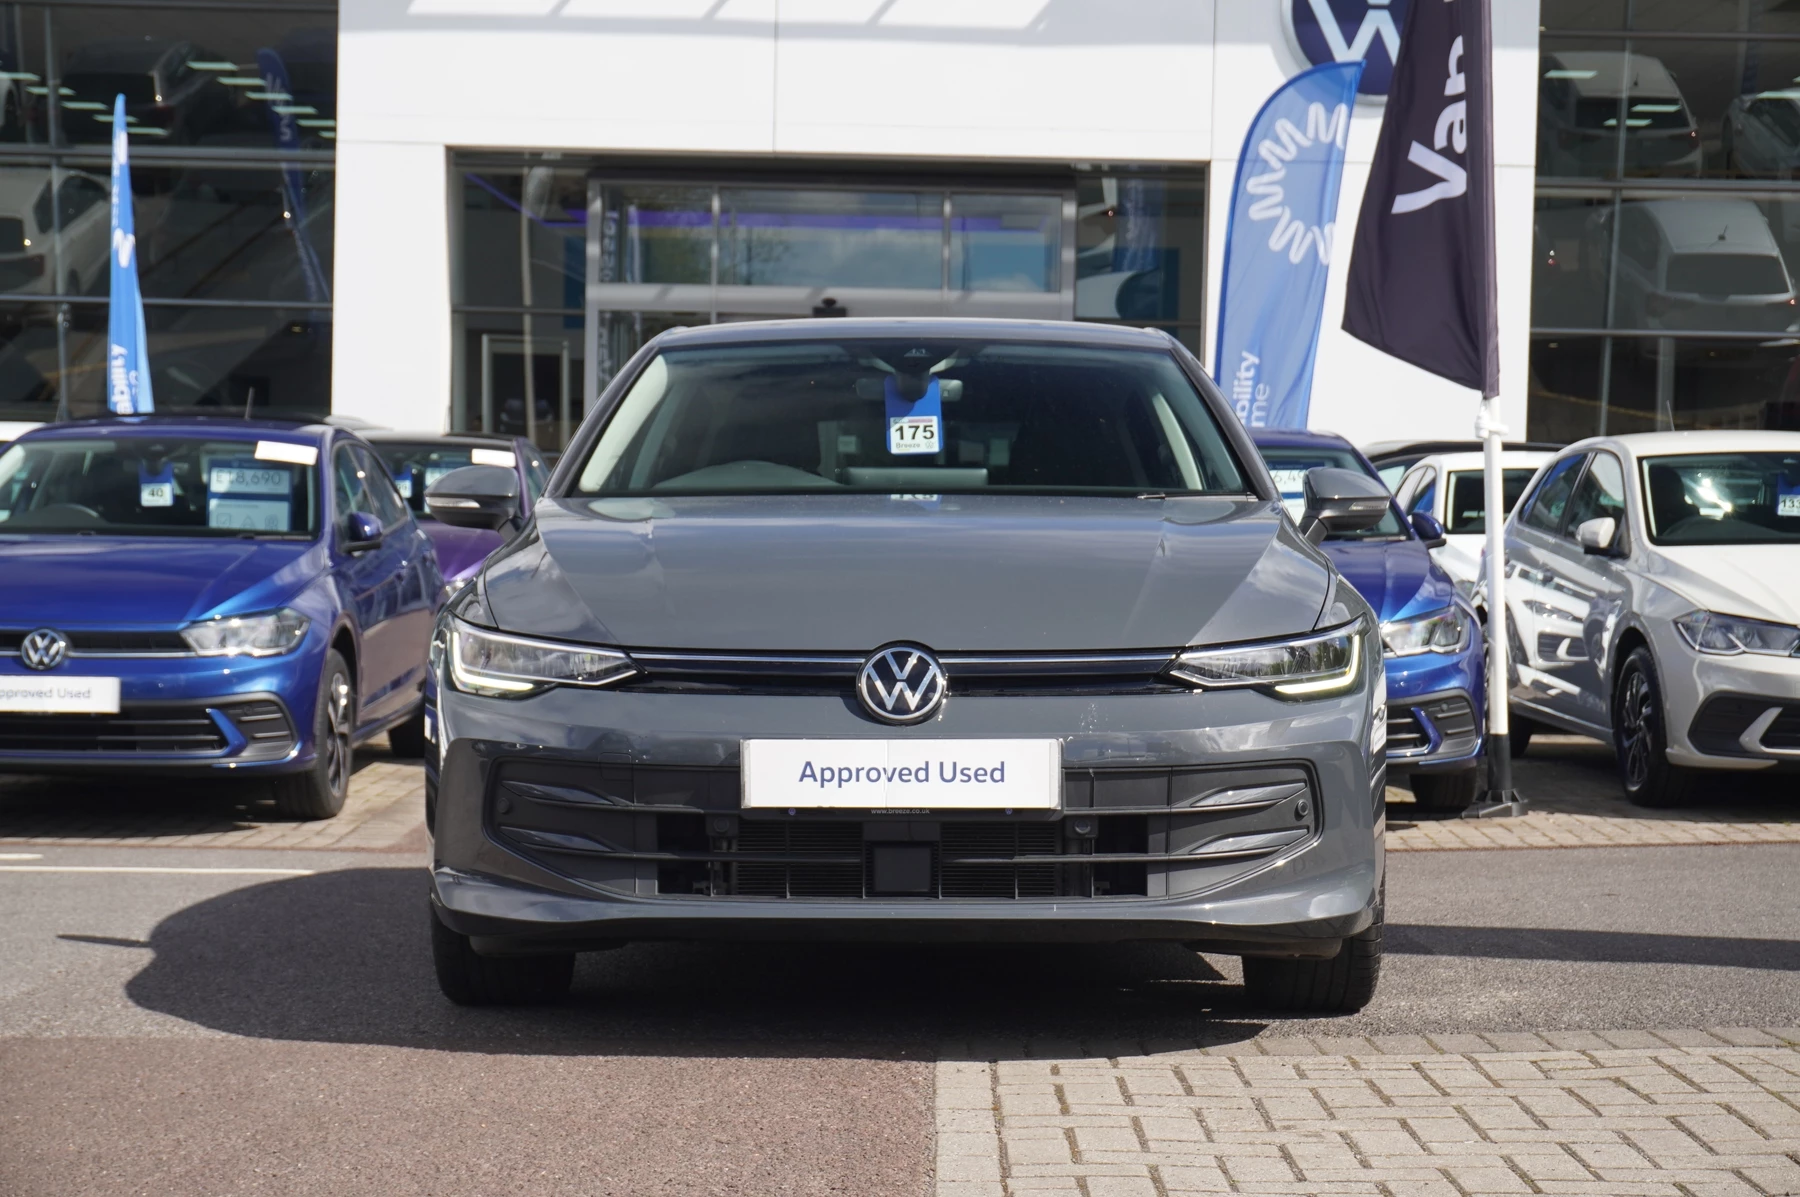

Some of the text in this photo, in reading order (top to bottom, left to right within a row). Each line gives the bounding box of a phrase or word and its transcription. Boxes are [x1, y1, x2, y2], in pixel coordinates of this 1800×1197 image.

[1232, 350, 1260, 428] bility
[894, 424, 935, 441] 175
[148, 486, 164, 498] 40
[57, 688, 91, 699] Used
[798, 760, 1006, 789] Approved Used
